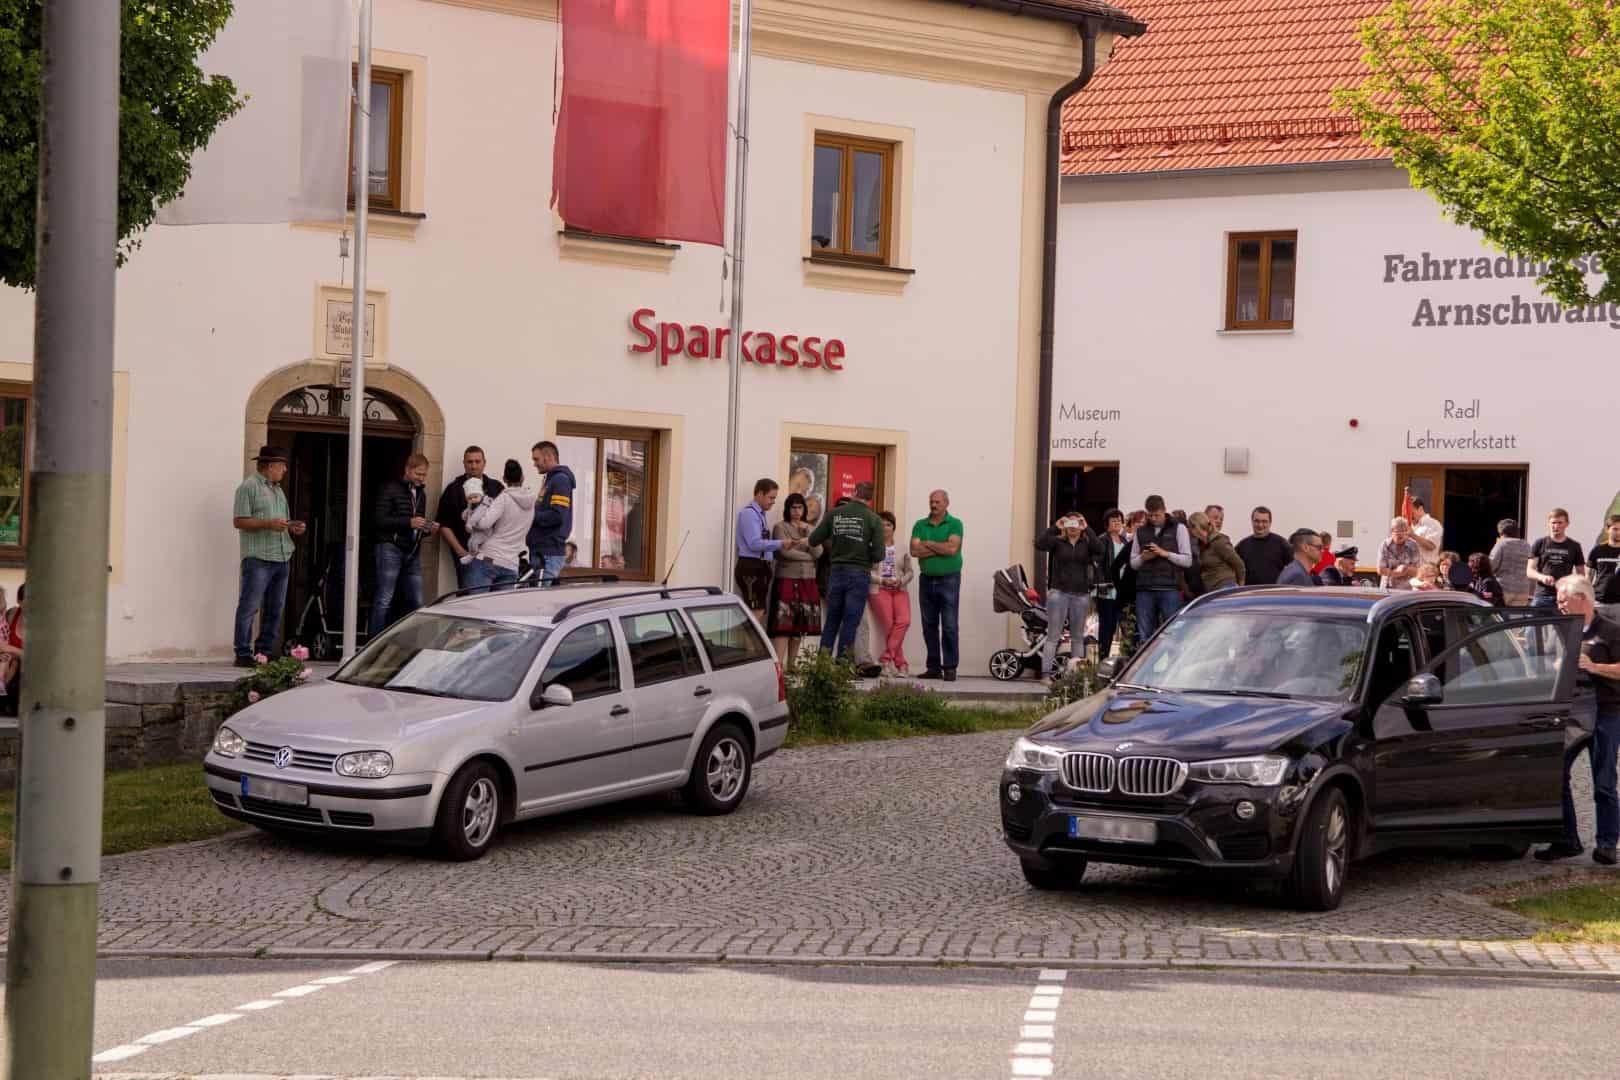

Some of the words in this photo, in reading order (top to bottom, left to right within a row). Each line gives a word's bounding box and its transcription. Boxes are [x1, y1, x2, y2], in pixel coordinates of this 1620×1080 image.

[1059, 402, 1121, 421] Museum
[1443, 399, 1480, 419] Radl
[1406, 430, 1516, 449] Lehrwerkstatt
